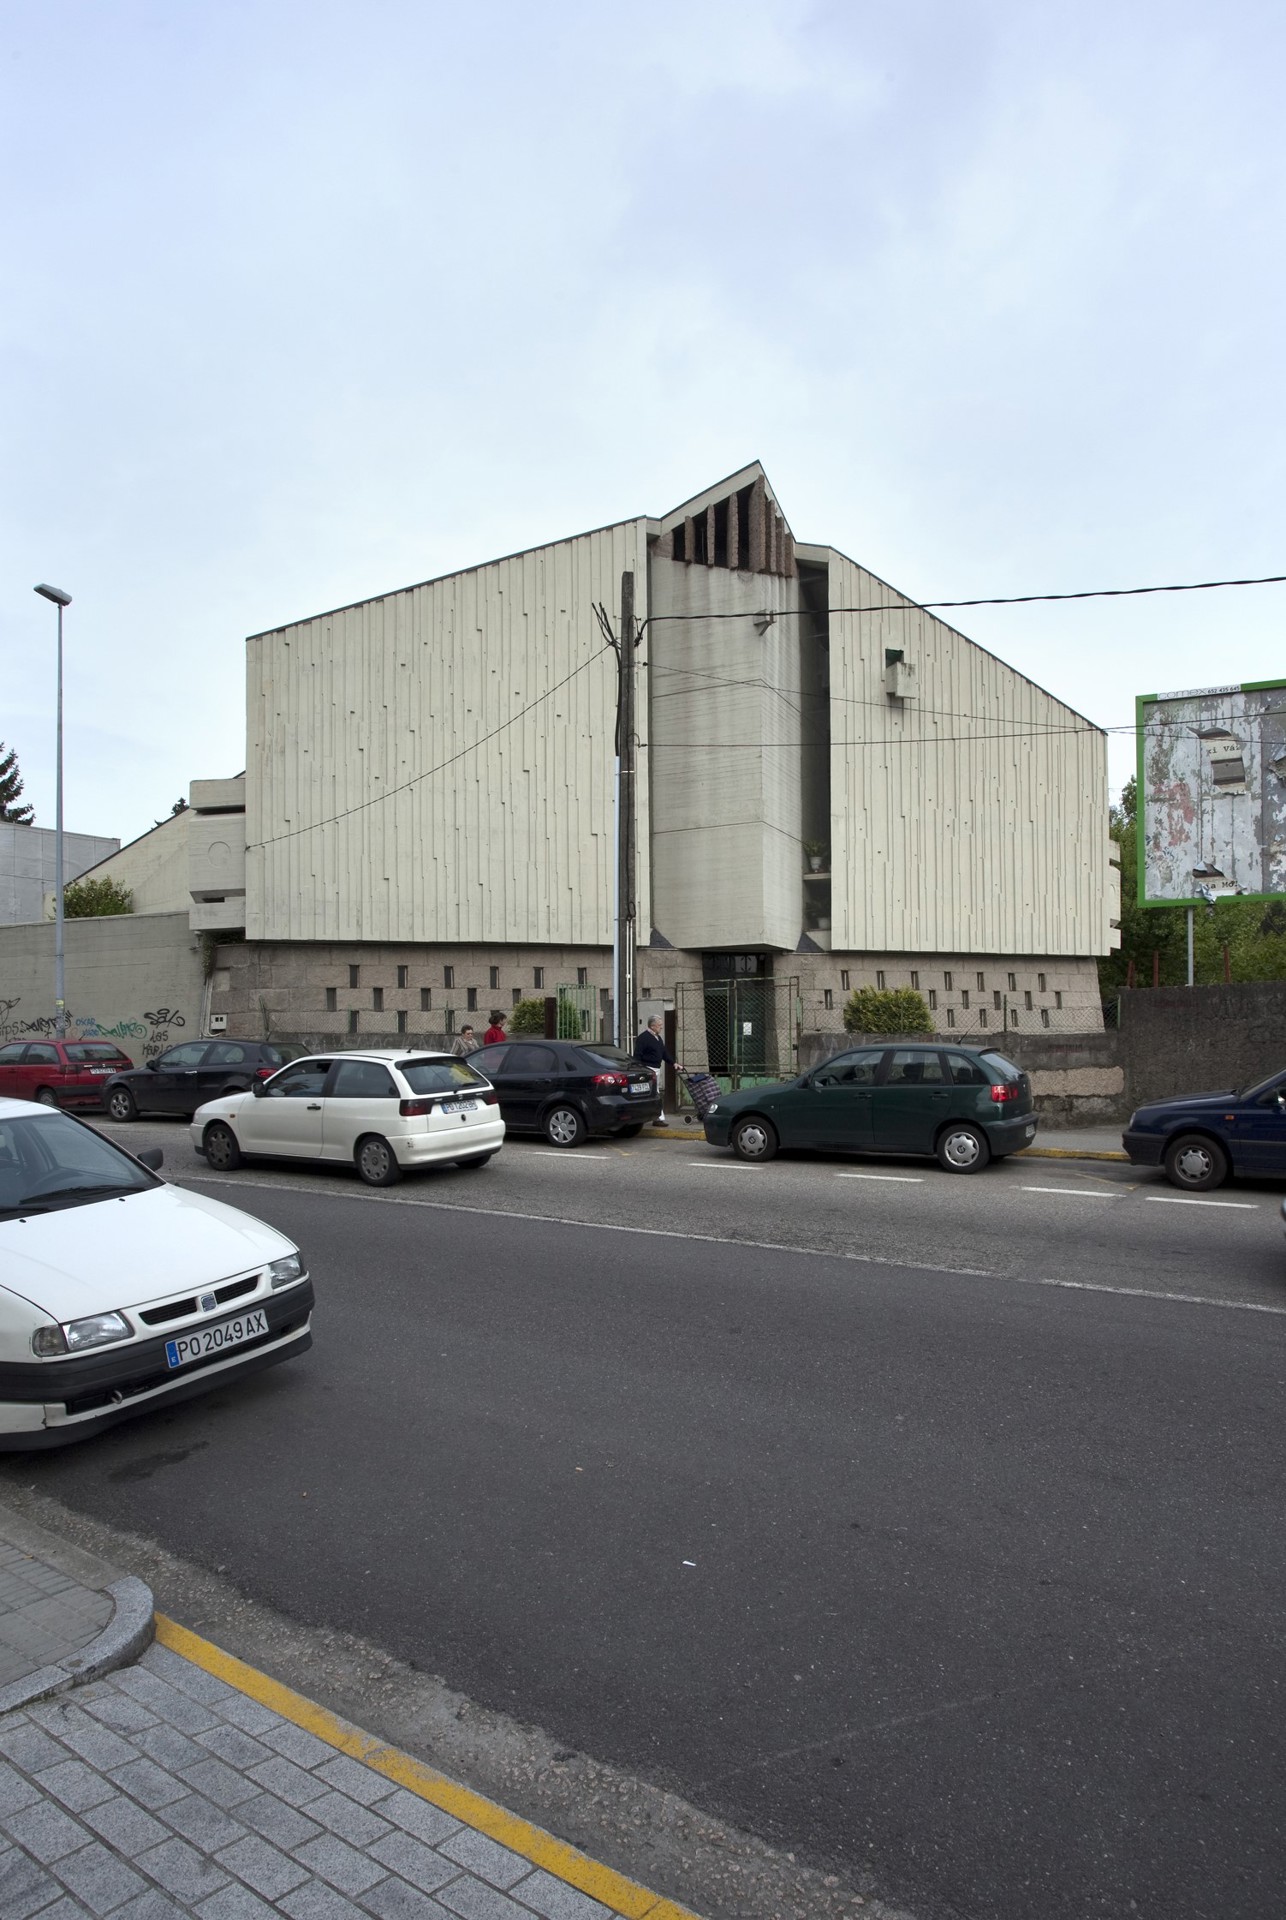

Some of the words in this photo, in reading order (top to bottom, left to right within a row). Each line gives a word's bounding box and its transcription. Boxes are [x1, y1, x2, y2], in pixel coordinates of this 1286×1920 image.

[177, 1336, 201, 1361] PO
[202, 1321, 243, 1352] 2049
[246, 1313, 265, 1336] AX
